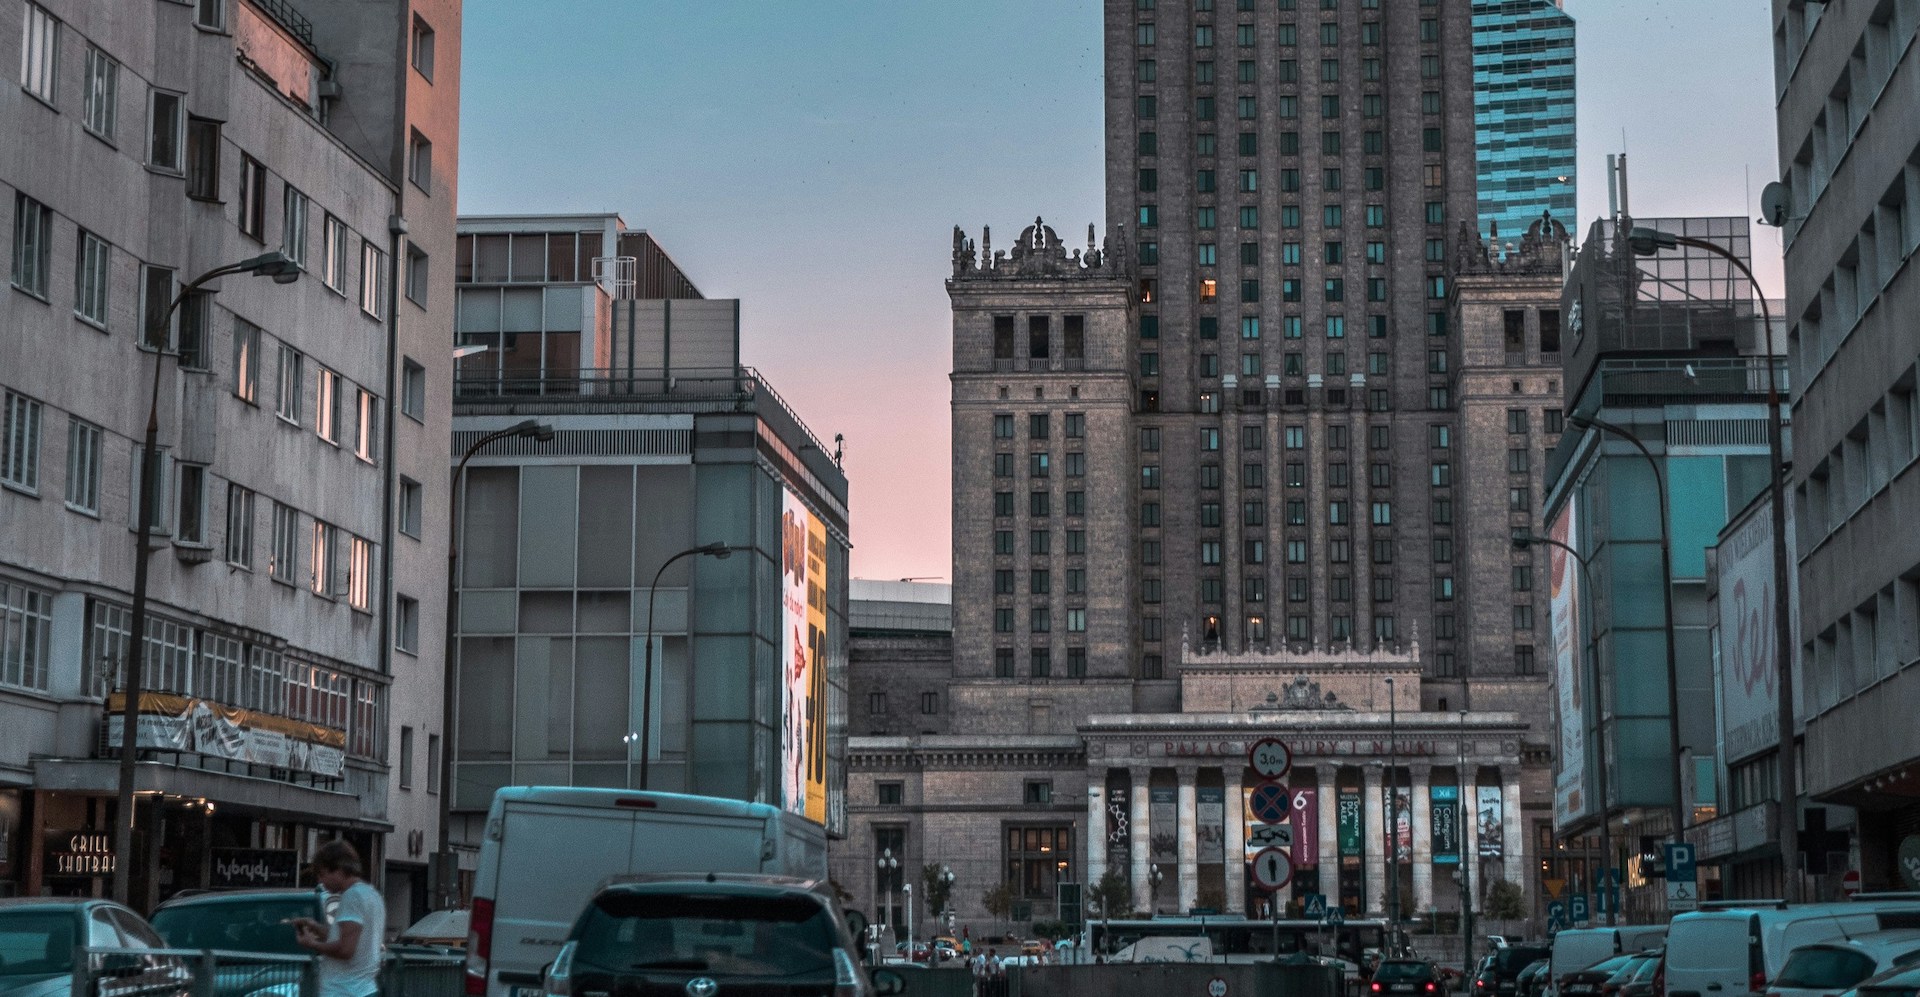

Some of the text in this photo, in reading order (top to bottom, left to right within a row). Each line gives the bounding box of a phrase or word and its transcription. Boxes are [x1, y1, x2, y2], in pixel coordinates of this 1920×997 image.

[1164, 740, 1231, 755] PAŁAC
[1293, 790, 1307, 810] 6
[1433, 807, 1441, 836] Civitas
[1441, 807, 1451, 850] Collegium
[70, 835, 109, 853] GRILL
[1672, 846, 1689, 870] P
[216, 857, 269, 882] hybrydy
[1573, 902, 1585, 918] P
